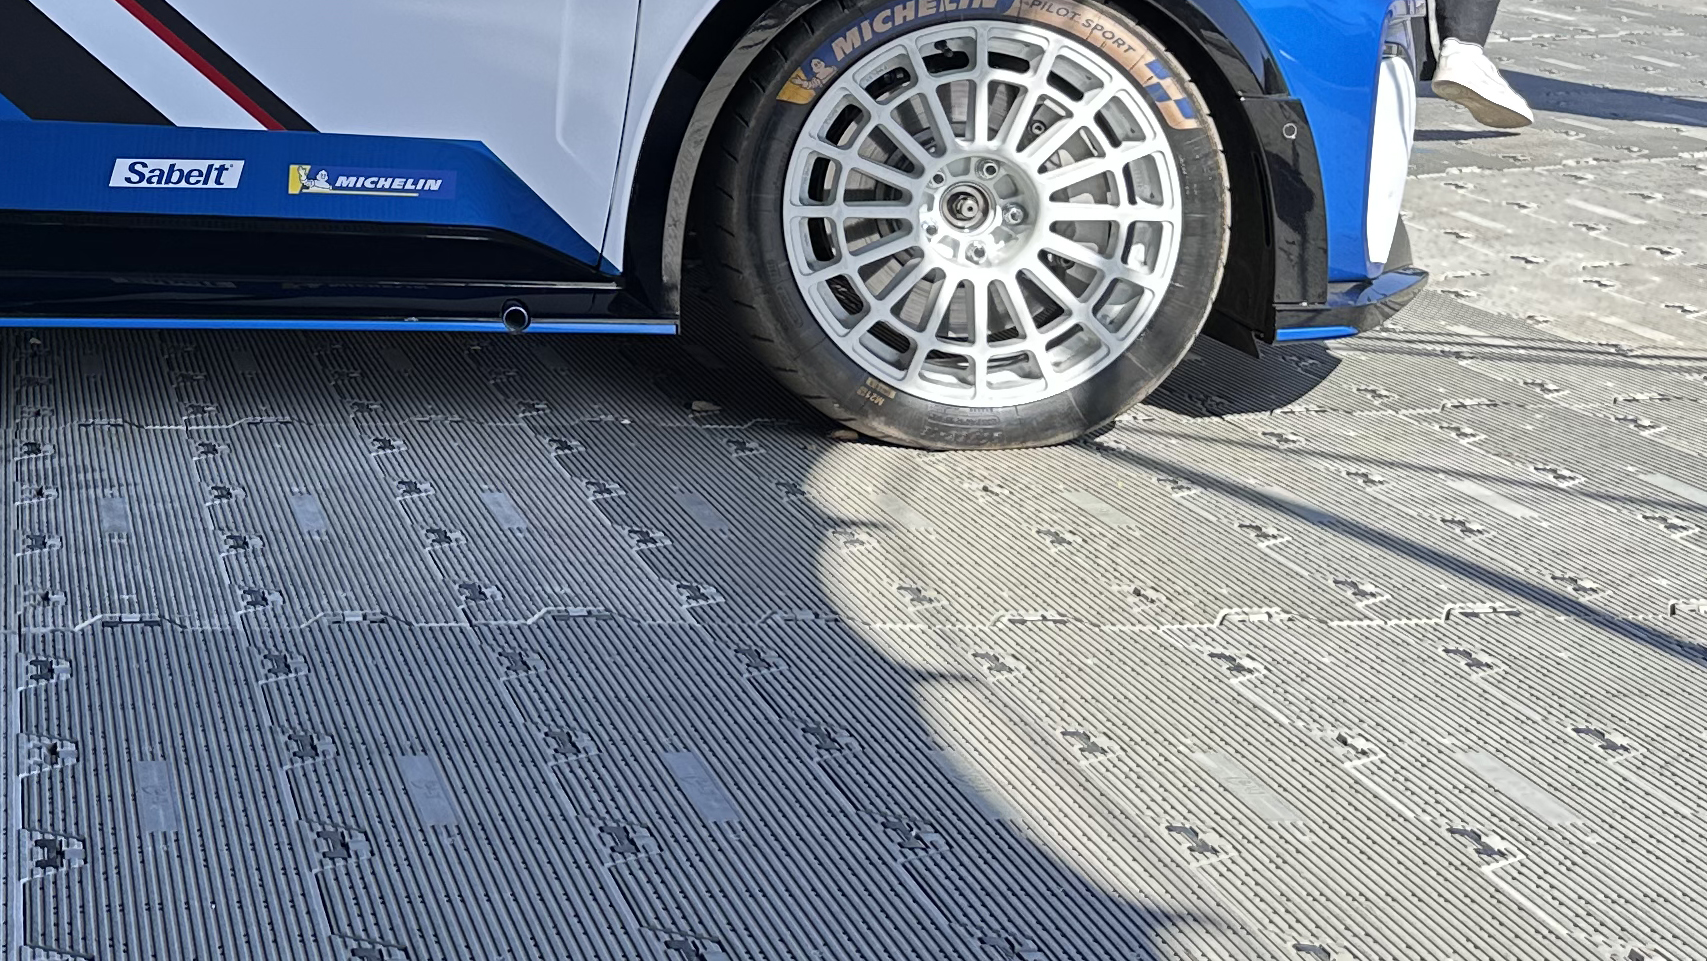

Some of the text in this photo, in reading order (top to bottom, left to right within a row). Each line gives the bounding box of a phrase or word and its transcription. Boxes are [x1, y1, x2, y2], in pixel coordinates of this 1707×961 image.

[1081, 18, 1137, 54] SPORT
[124, 160, 229, 187] Sabelt
[335, 175, 443, 191] MICHELIN
